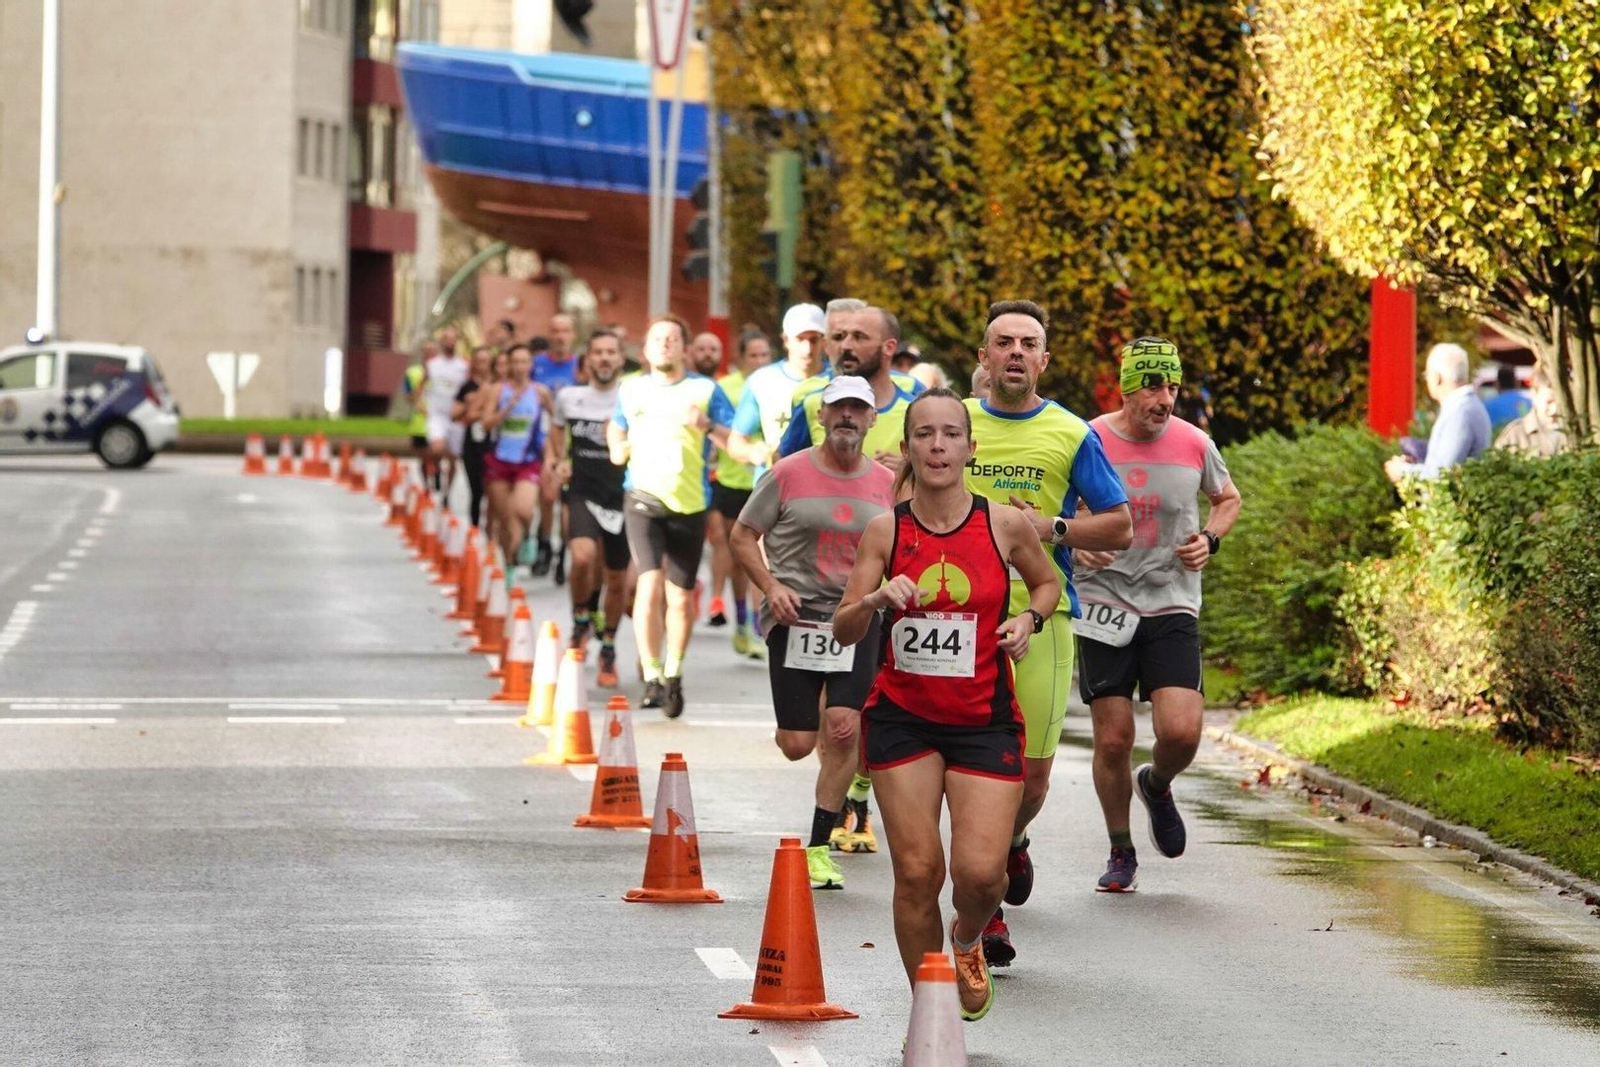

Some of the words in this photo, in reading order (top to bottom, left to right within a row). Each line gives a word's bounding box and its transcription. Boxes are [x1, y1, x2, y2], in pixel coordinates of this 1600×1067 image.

[970, 464, 1045, 481] DEPORTE
[993, 477, 1041, 492] Atlántico
[1086, 603, 1127, 631] 104
[800, 632, 844, 657] 130
[903, 626, 962, 656] 244
